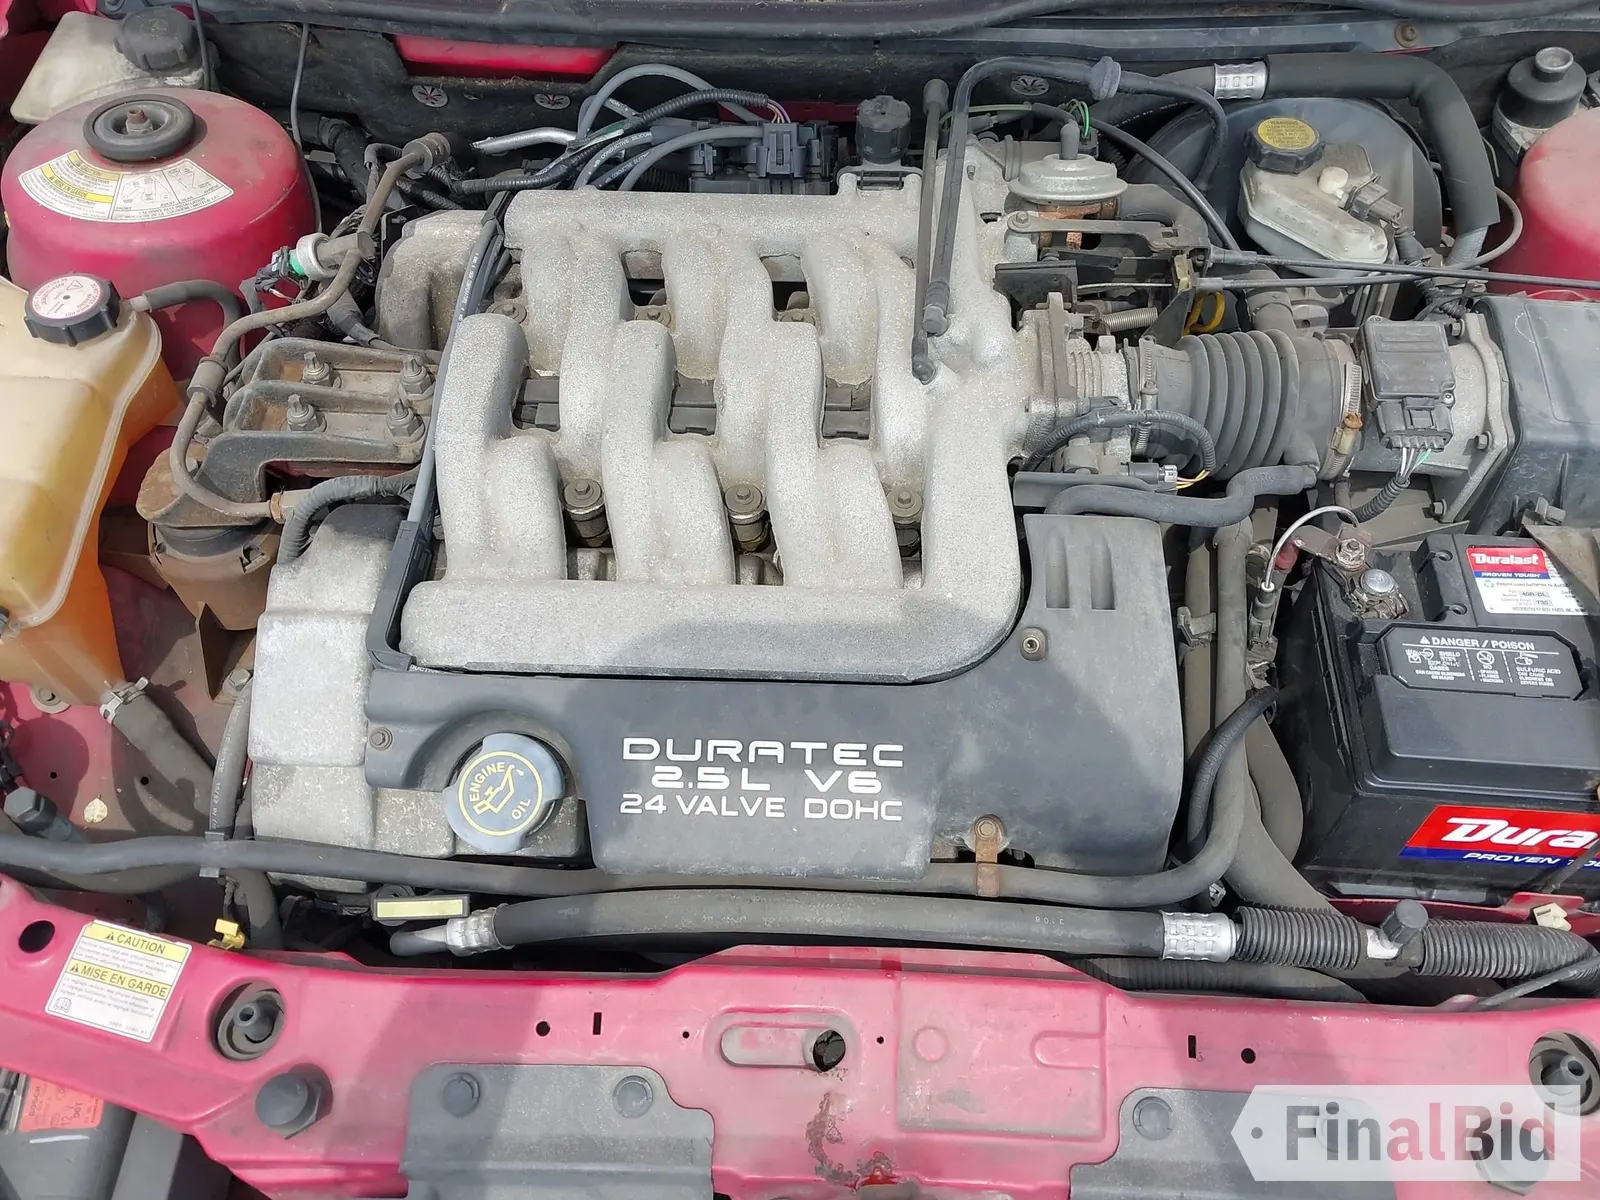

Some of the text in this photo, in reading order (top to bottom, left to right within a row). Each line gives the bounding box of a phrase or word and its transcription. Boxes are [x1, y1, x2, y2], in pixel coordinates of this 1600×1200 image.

[600, 139, 630, 160] CONDUCTIVE
[1470, 552, 1539, 565] Duralast
[1431, 636, 1480, 648] DANGER
[1491, 640, 1535, 650] POISON
[622, 737, 904, 768] DURATEC
[469, 761, 506, 802] ENGINE
[651, 765, 883, 794] 2.5L V6
[511, 798, 532, 820] OIL
[620, 793, 903, 821] 24 VALVE DOHC
[1463, 852, 1560, 864] PROVEN
[116, 933, 166, 955] CAUTION
[80, 965, 168, 998] MISE EN GARDE
[28, 1086, 42, 1117] BOSCH
